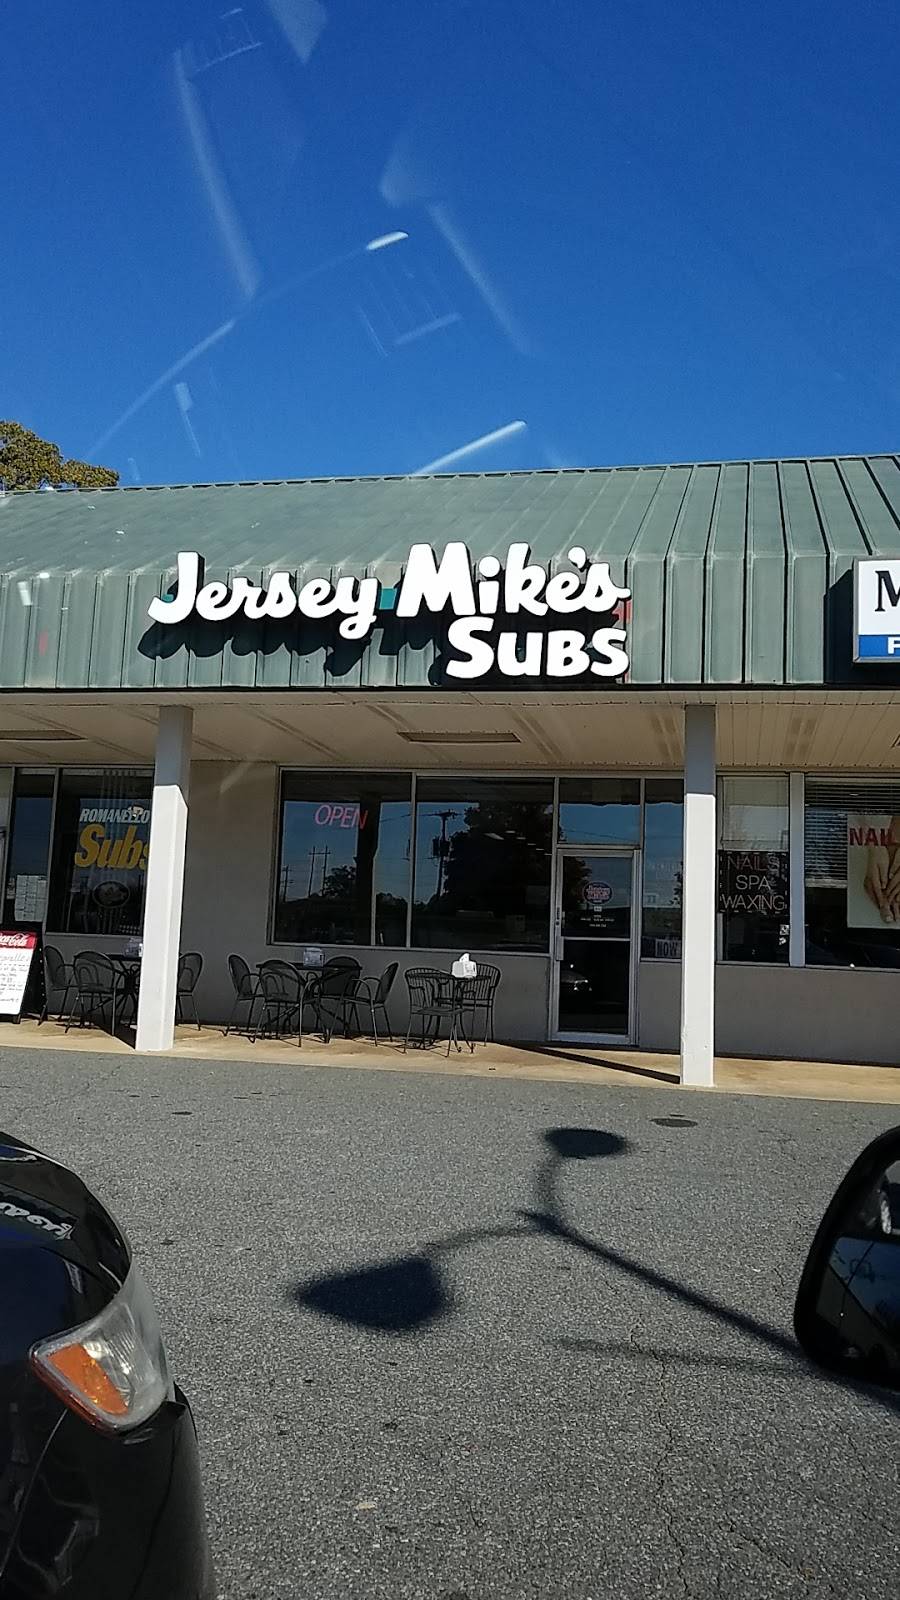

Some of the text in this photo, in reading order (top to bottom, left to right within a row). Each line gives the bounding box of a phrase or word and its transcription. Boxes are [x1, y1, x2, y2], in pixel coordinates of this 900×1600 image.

[147, 541, 631, 640] Jersey Mike's
[314, 804, 369, 831] OPEN
[74, 823, 150, 870] Subs
[727, 854, 780, 872] NAILS
[735, 873, 772, 891] SPA
[720, 892, 785, 911] WAXING
